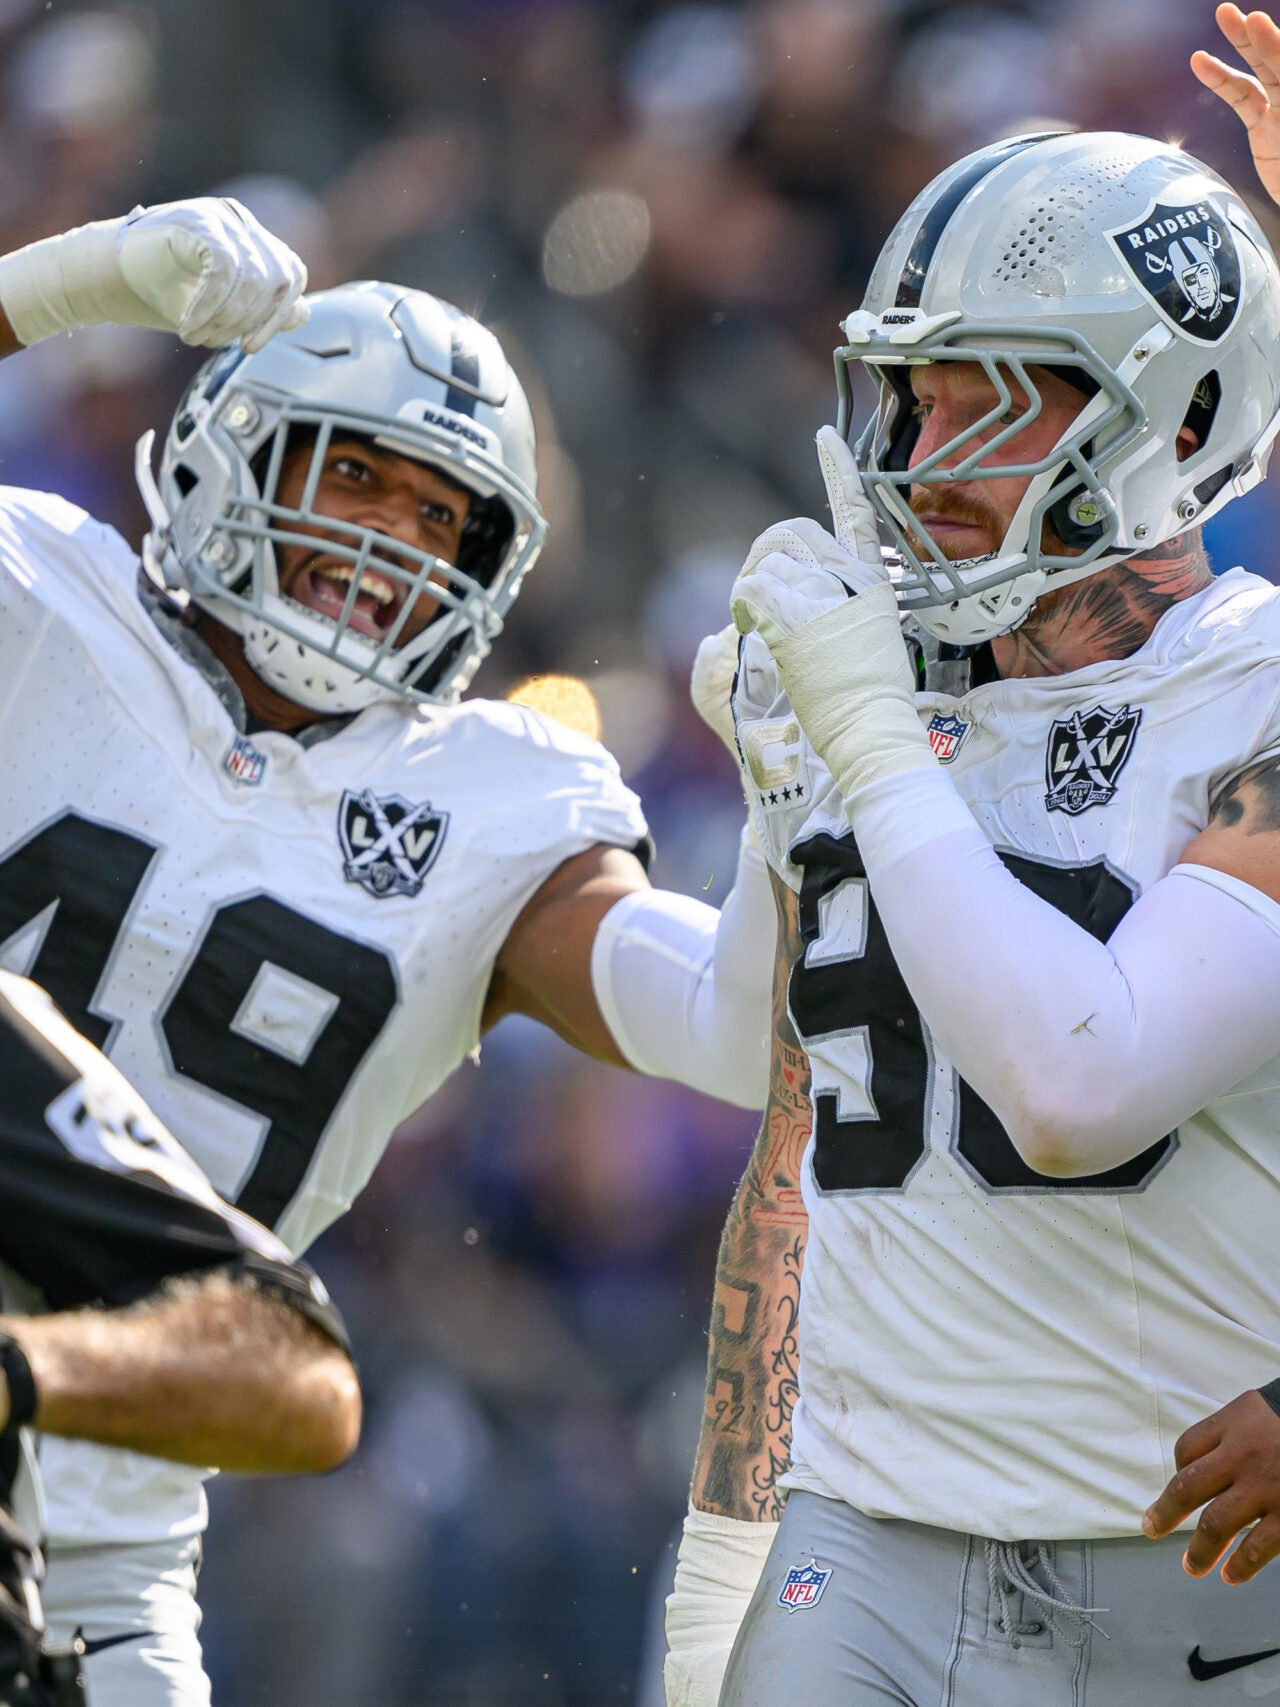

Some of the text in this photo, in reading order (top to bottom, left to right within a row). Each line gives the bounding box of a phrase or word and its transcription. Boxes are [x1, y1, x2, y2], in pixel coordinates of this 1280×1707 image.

[1127, 206, 1210, 249] RAIDERS
[881, 315, 916, 324] RAIDERS
[423, 410, 488, 450] RAIDERS
[928, 730, 955, 756] NFL
[1053, 734, 1128, 774] LXV
[228, 750, 259, 779] NFL
[350, 814, 437, 861] LXV
[783, 1583, 814, 1603] NFL
